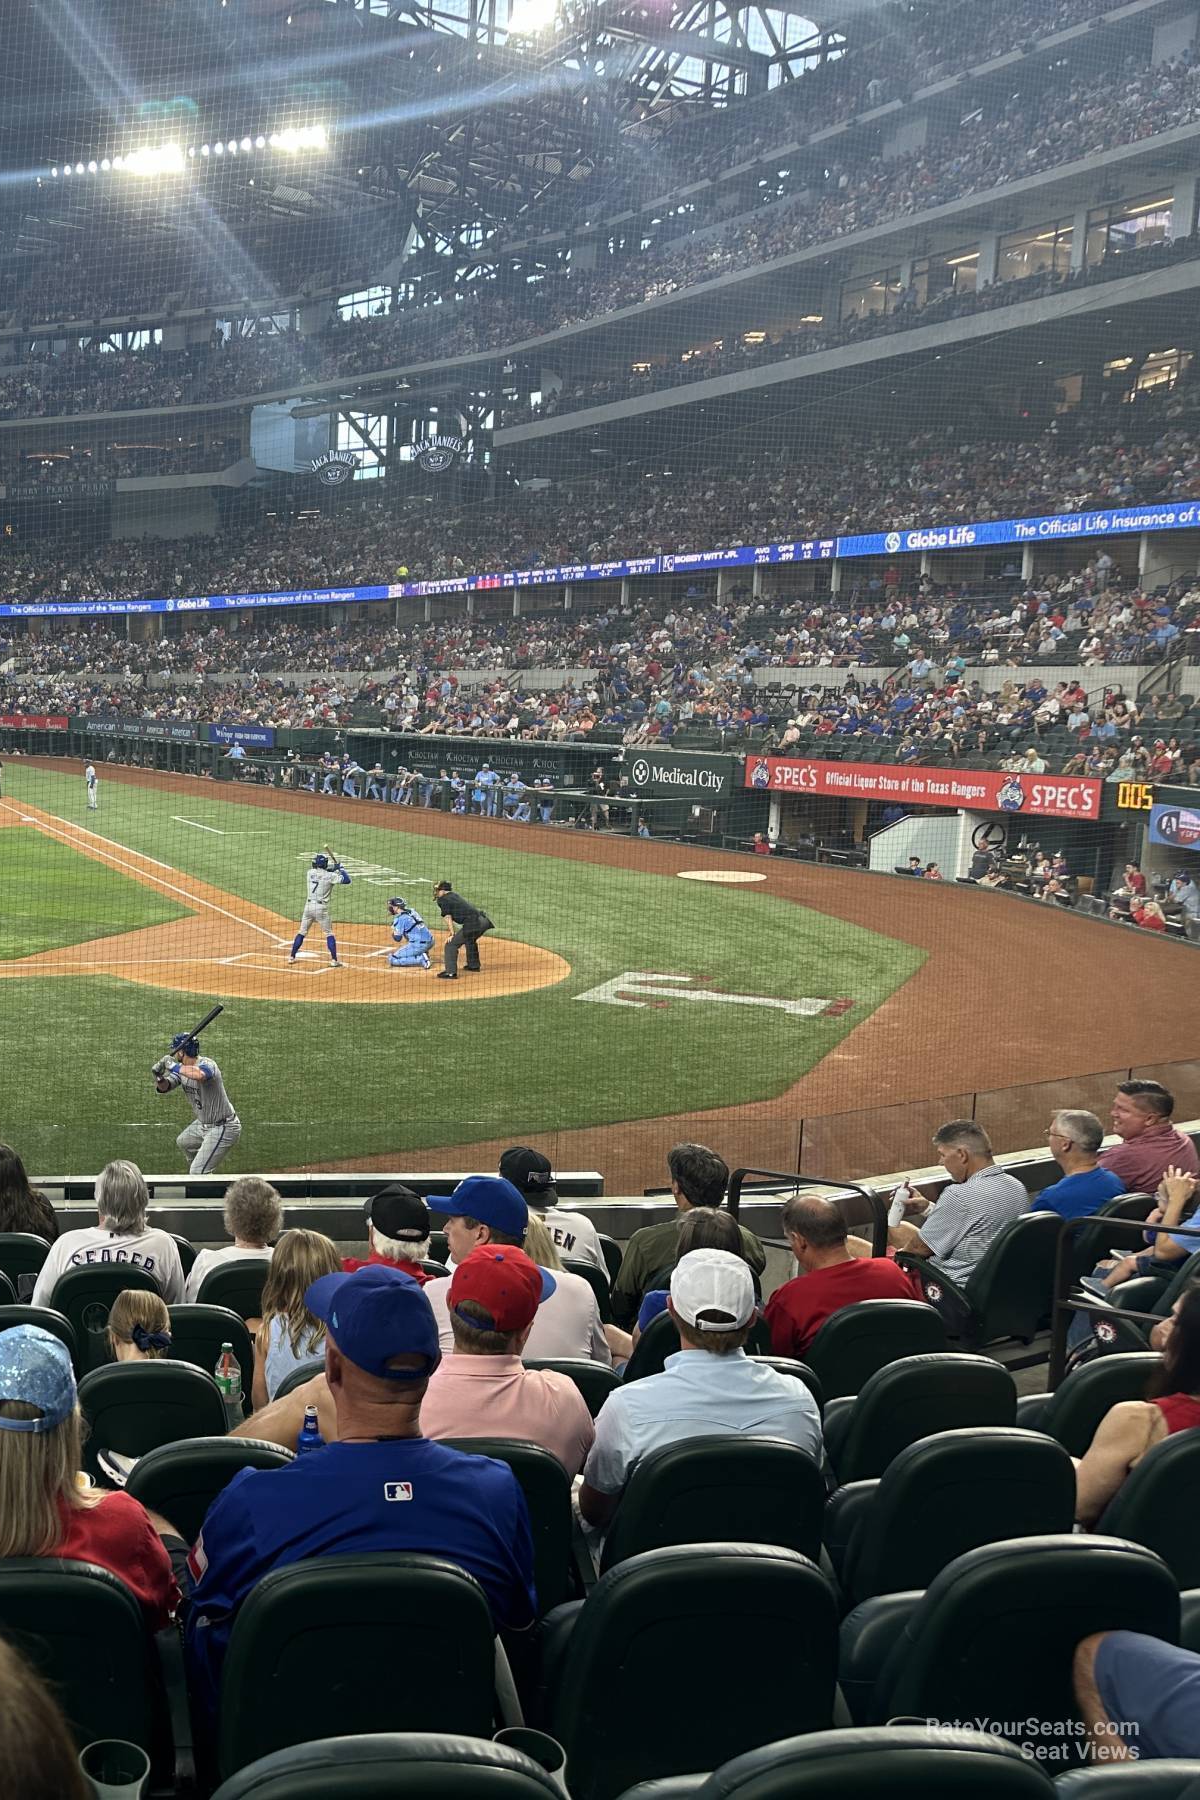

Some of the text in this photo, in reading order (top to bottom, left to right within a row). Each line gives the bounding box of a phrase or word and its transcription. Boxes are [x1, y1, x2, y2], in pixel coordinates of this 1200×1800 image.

[410, 439, 430, 458] JACK
[311, 456, 329, 472] JACK
[907, 507, 1194, 549] Globe Life The Official Life Insurance of
[703, 552, 724, 560] WITT
[197, 600, 209, 608] Life
[652, 766, 724, 792] Medical City
[774, 765, 1094, 810] SPEC'S Official Liquor Store of the Texas Rangers SPEC'S
[1118, 783, 1153, 809] 005
[312, 881, 319, 893] 7
